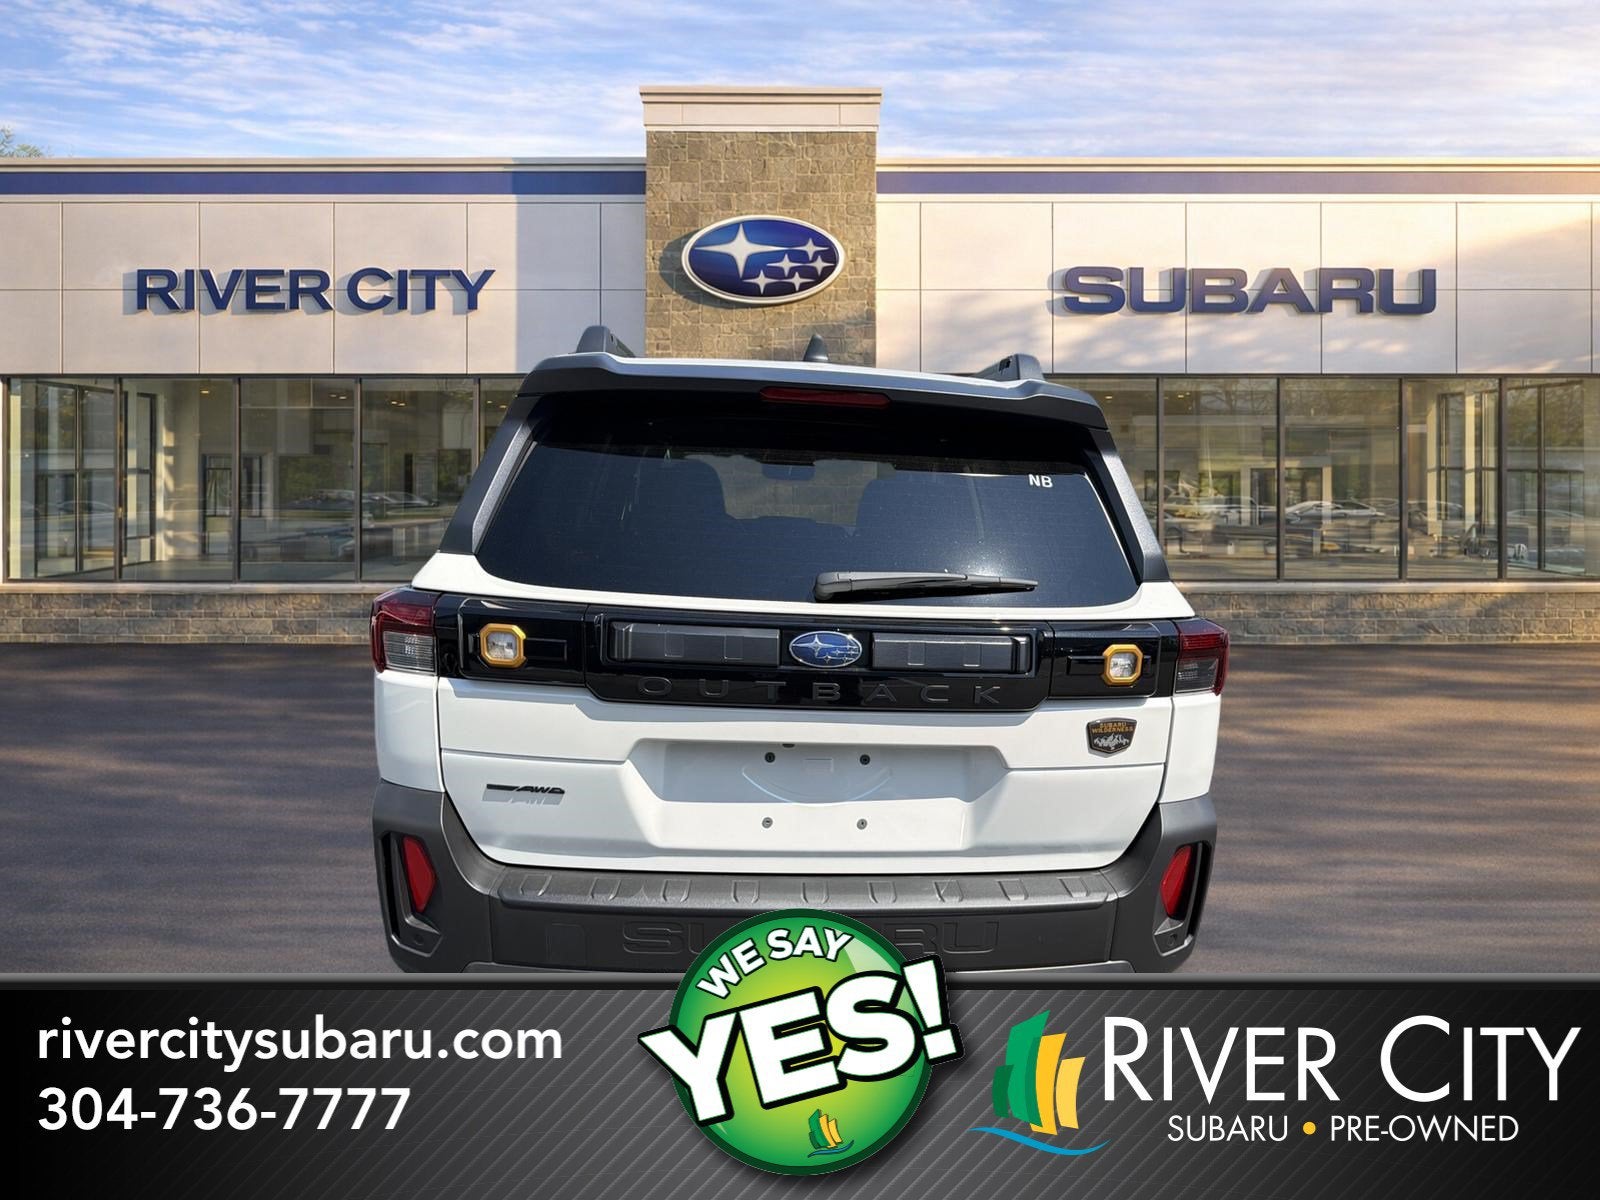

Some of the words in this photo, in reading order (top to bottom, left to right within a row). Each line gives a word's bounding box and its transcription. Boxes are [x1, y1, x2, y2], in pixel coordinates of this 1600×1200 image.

[136, 268, 333, 311] RIVER
[347, 267, 495, 311] CITY
[1063, 266, 1437, 315] SUBARU
[1028, 474, 1053, 488] NB
[638, 676, 1001, 704] OUTBACK
